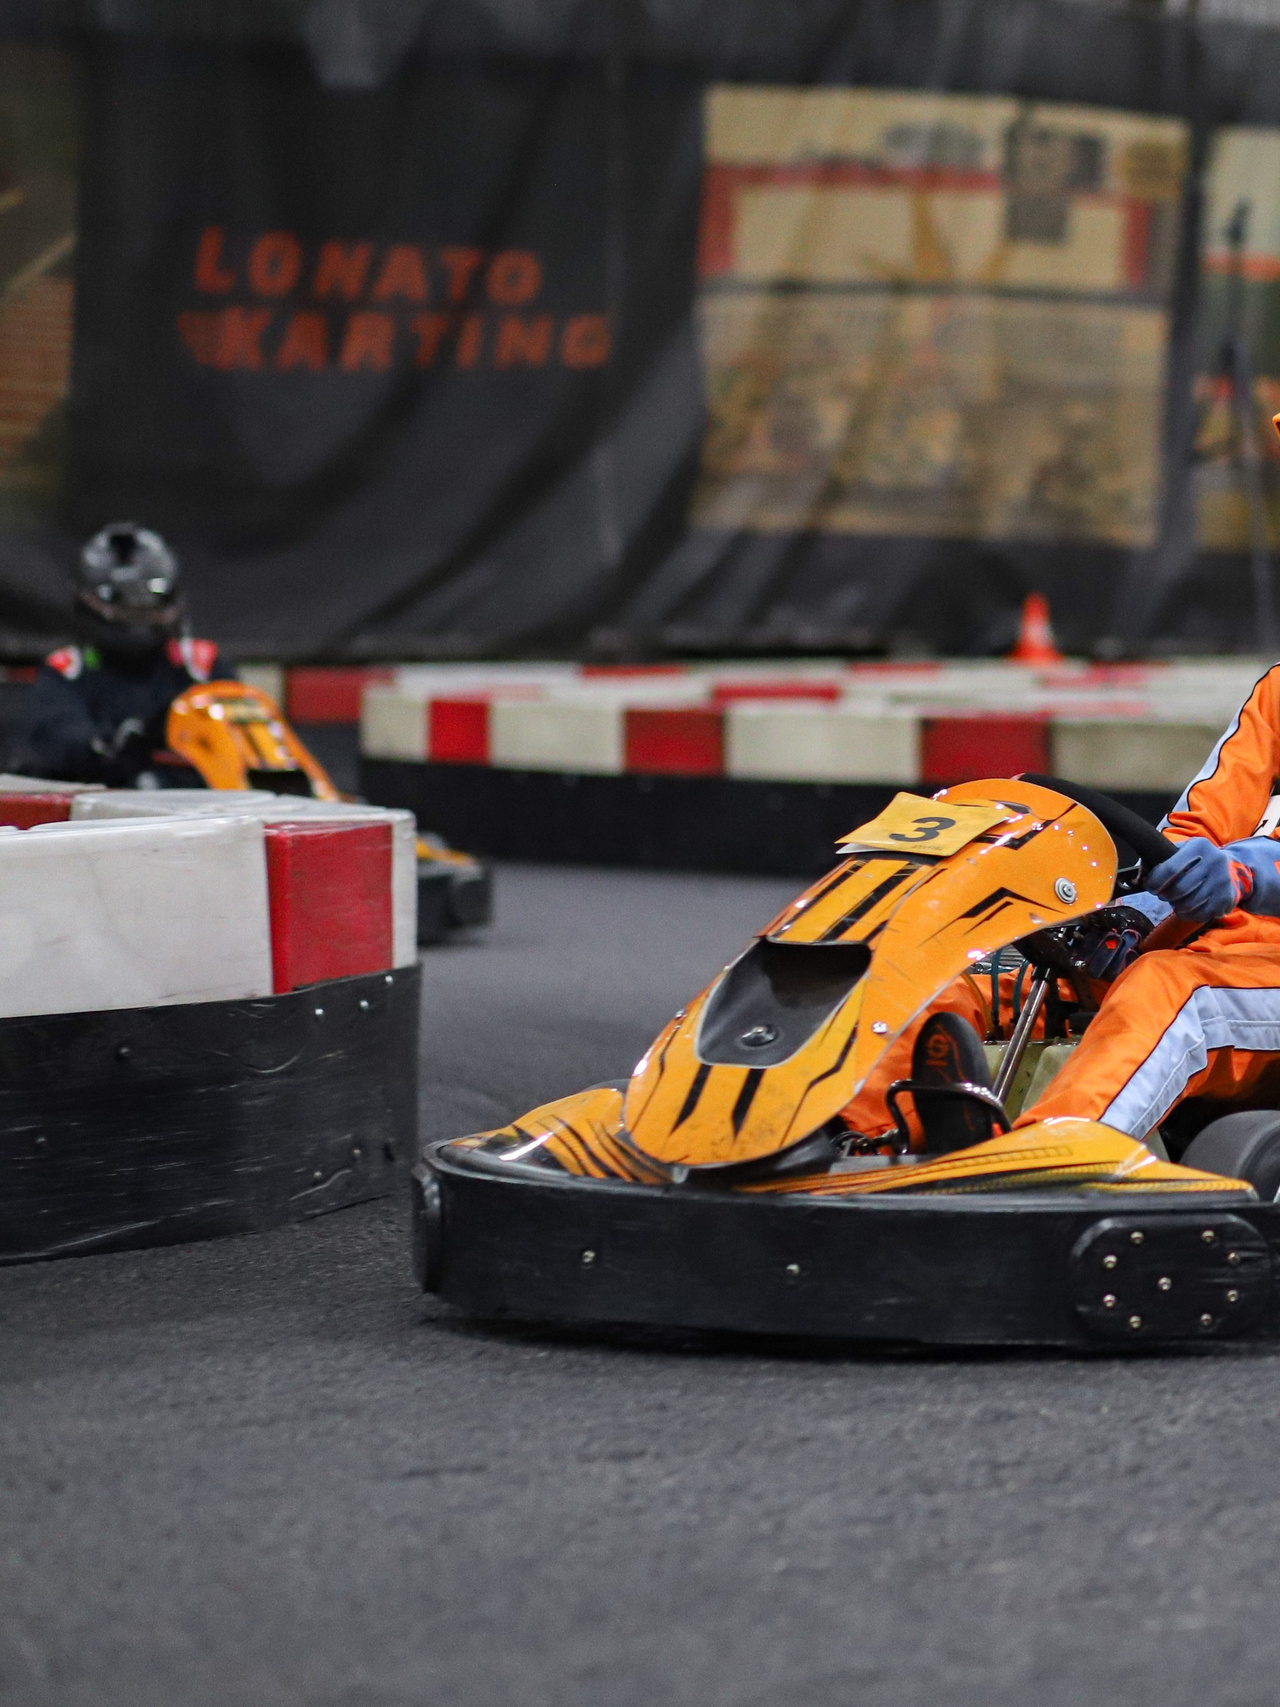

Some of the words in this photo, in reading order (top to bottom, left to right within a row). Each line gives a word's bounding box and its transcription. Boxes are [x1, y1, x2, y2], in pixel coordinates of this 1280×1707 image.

[194, 226, 542, 303] LONATO
[205, 306, 614, 372] KARTING
[888, 816, 956, 843] 3
